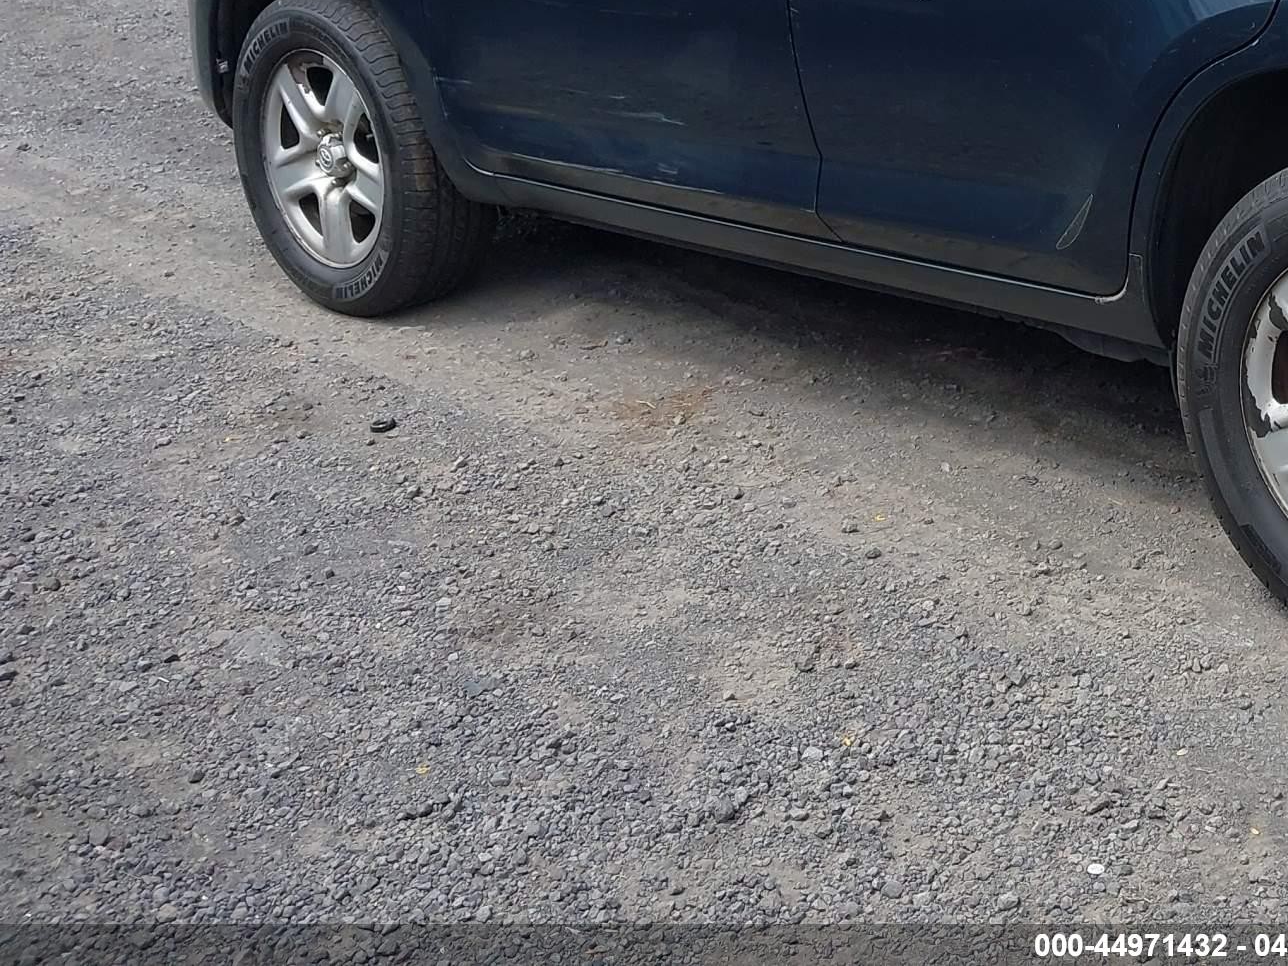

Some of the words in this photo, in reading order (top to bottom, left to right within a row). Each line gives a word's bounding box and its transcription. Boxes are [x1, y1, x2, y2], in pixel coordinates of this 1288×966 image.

[243, 21, 289, 74] MICHELIN
[335, 252, 384, 299] MICHELIN
[1197, 231, 1266, 360] MICHELIN
